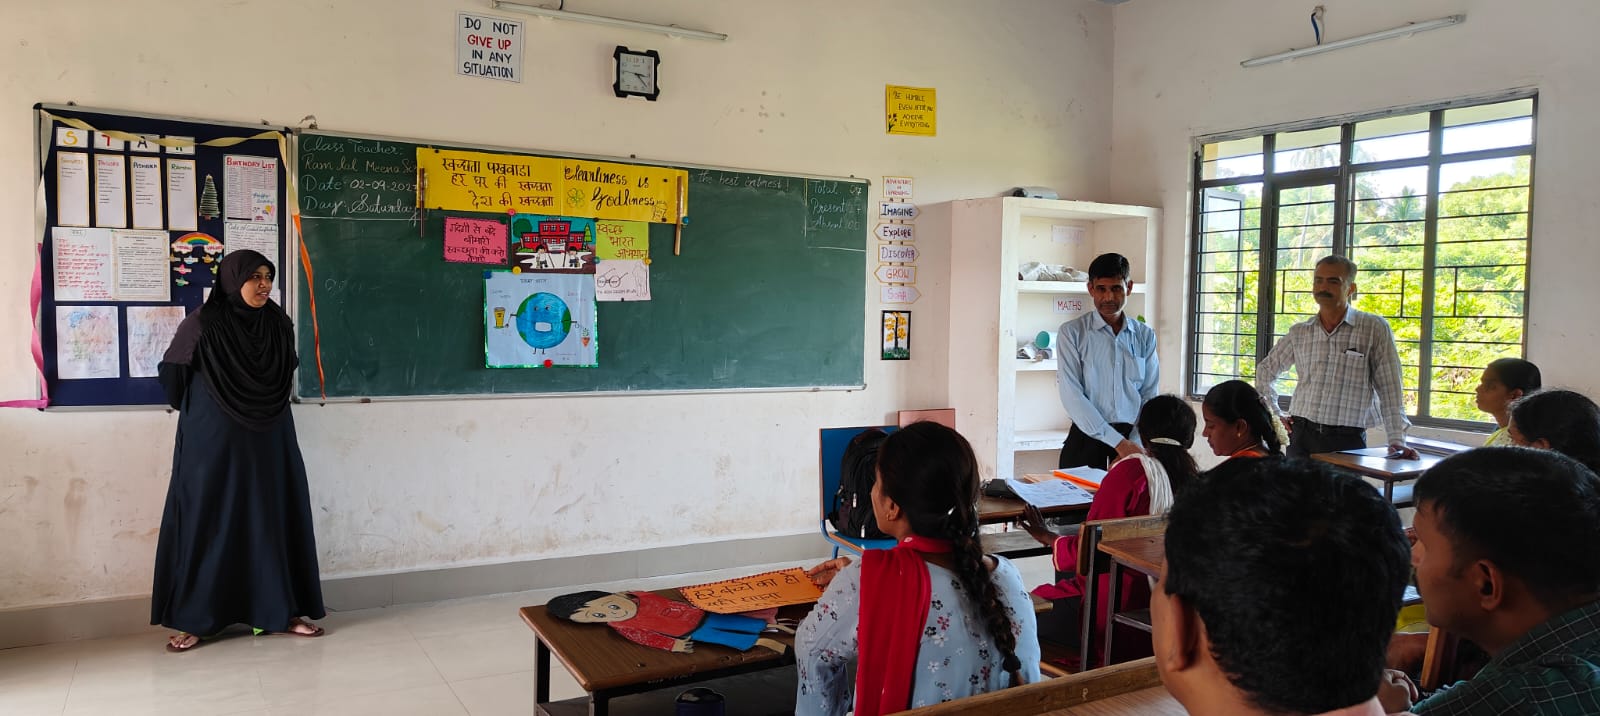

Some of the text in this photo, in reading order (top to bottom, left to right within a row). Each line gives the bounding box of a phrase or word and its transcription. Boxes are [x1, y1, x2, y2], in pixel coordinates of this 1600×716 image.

[464, 17, 518, 35] DO NOT
[467, 34, 512, 50] GIVE UP
[472, 49, 512, 64] IN ANY
[463, 61, 514, 79] SITUATION
[63, 131, 78, 145] S
[303, 136, 345, 153] Class
[494, 175, 507, 189] की
[719, 172, 740, 186] best
[499, 191, 513, 207] की
[881, 204, 913, 216] IMAGINE
[609, 236, 638, 248] भारत
[886, 268, 910, 280] GROW
[1057, 300, 1082, 311] MATHS
